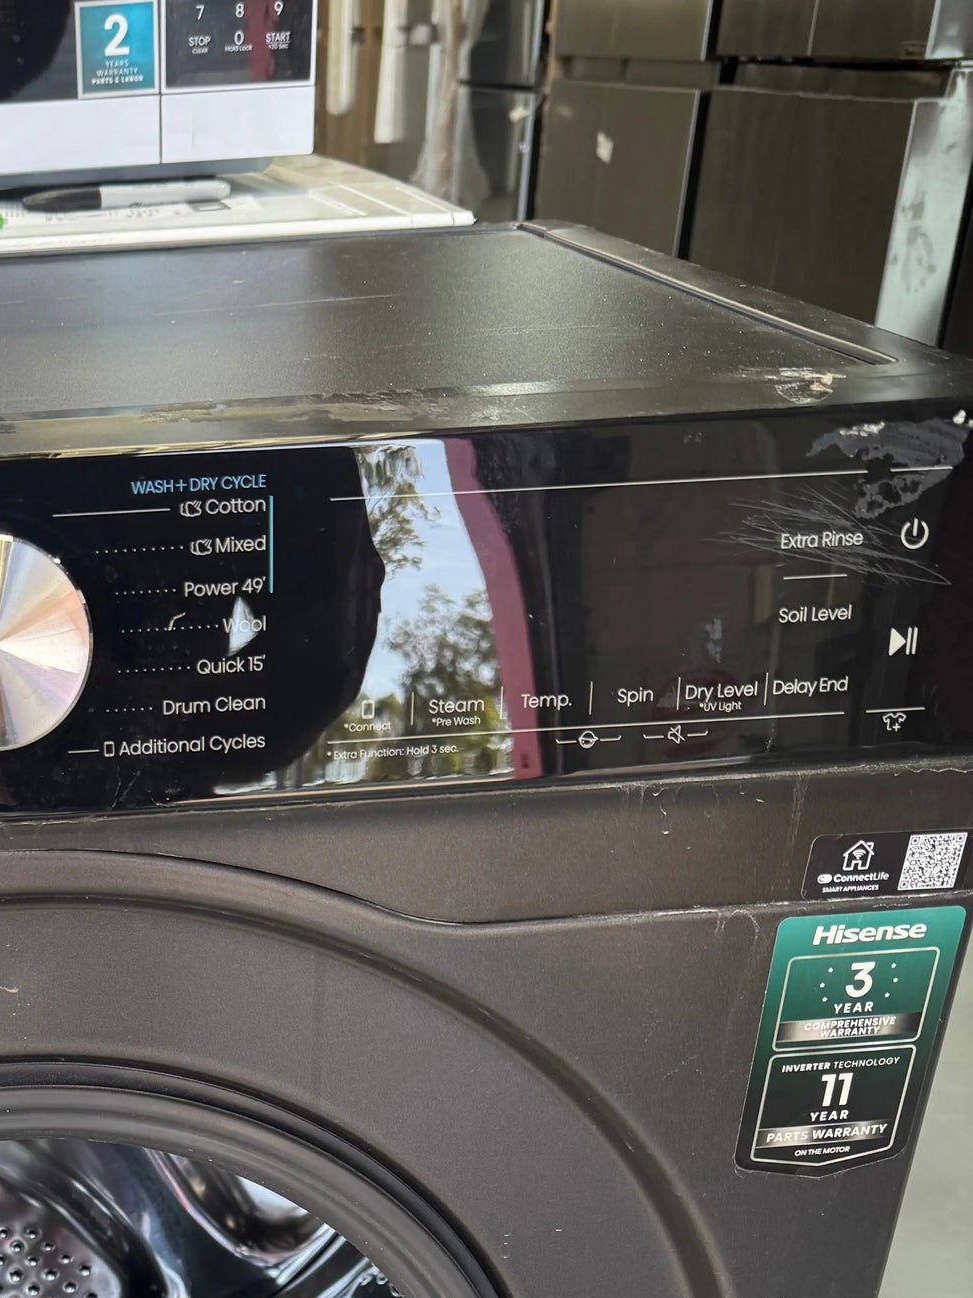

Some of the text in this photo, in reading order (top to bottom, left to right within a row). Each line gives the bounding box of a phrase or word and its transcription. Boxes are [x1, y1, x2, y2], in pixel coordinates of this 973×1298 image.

[195, 4, 205, 20] 7
[235, 3, 245, 18] 8
[274, 1, 284, 16] 9
[104, 13, 130, 57] 2
[188, 36, 211, 47] STOP
[234, 30, 244, 45] 0
[266, 32, 291, 42] START
[105, 59, 129, 68] YEARS
[96, 67, 139, 77] WARRANTY
[91, 77, 114, 85] PARTS
[221, 474, 267, 490] CYCLE
[206, 498, 267, 515] Cotton
[215, 535, 267, 553] Mixed
[780, 531, 864, 550] Extra Rinse
[184, 580, 239, 598] Power
[778, 604, 853, 624] Soil Level
[222, 614, 267, 633] Wool
[196, 658, 245, 675] Quick
[685, 680, 758, 703] Dry Level
[772, 675, 849, 697] Delay End
[521, 692, 572, 711] Temp.
[617, 687, 654, 707] Spin
[162, 696, 267, 716] Drum Clean
[429, 698, 485, 715] Steam
[718, 700, 742, 713] Light
[453, 715, 481, 727] Wash
[119, 733, 266, 757] Additional Cycles
[333, 749, 358, 760] Extra
[359, 746, 405, 759] Function:
[407, 744, 430, 756] Hold
[431, 744, 438, 754] 3
[833, 871, 890, 883] ConnectLife
[821, 884, 880, 894] SMART APPLIANCES
[812, 923, 928, 946] Hisense
[845, 961, 876, 999] 3
[833, 1001, 875, 1015] YEAR
[803, 1016, 896, 1031] COMPREHENSIVE
[819, 1025, 881, 1039] WARRANTY
[781, 1056, 900, 1073] INVERTER TECHNOLOGY
[821, 1072, 854, 1108] 11
[810, 1110, 850, 1122] YEAR
[766, 1123, 888, 1144] PARTS WARRANTY
[794, 1146, 851, 1157] ON THE MOTOR
